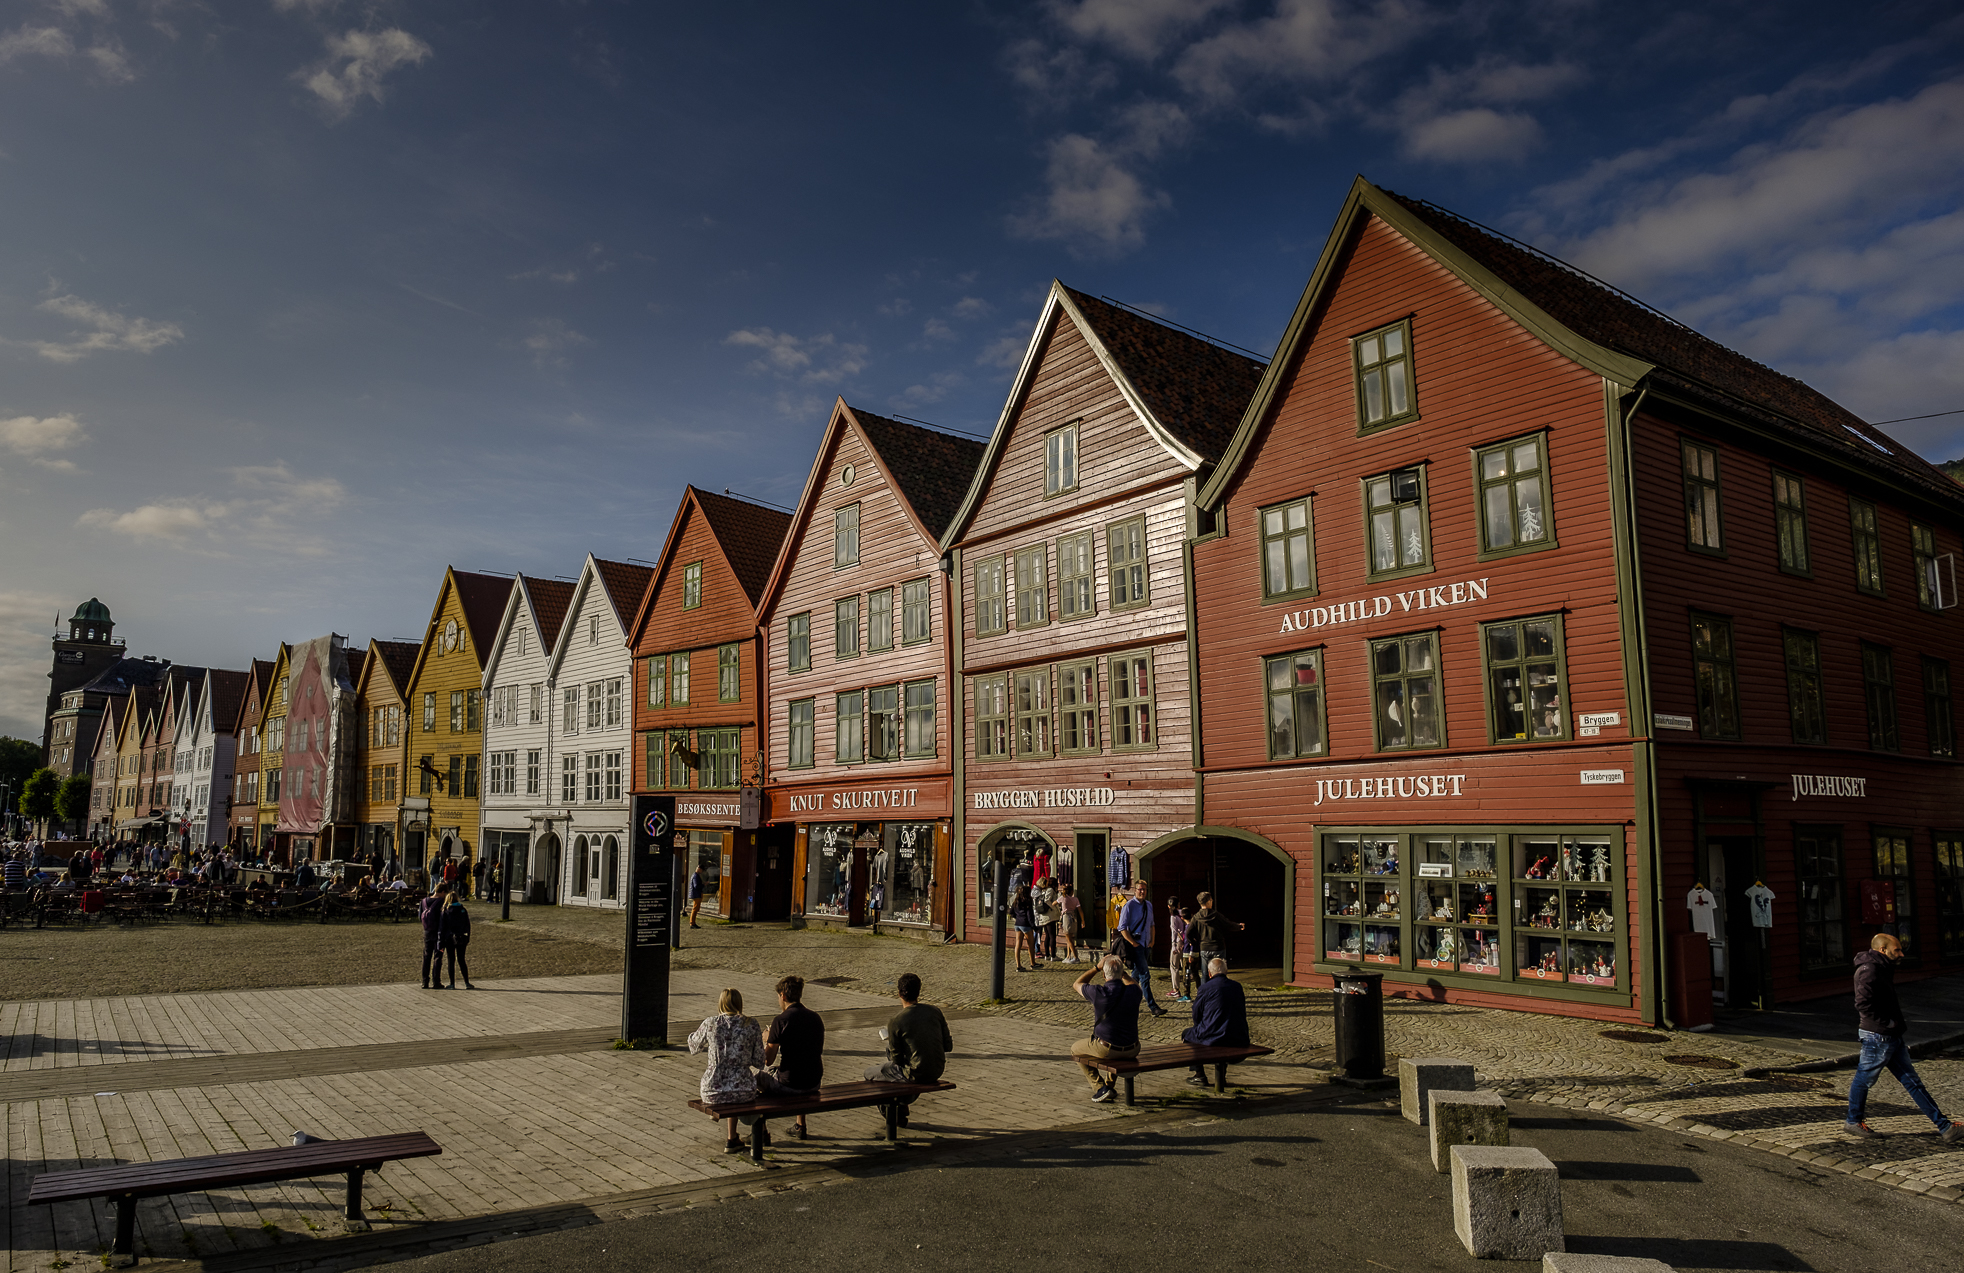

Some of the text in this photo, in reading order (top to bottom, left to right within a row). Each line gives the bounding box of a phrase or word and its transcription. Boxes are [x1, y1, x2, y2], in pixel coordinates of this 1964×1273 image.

[1279, 577, 1490, 634] AUDHILD VIKEN
[1584, 715, 1615, 726] Bryggen
[1583, 772, 1622, 783] Tyskebryggen
[1791, 773, 1867, 802] JULEHUSET
[789, 788, 919, 812] KNUT SKURTVEIT
[974, 787, 1115, 809] BRYGGEN HUSFLID
[1314, 774, 1467, 806] JULEHUSET
[677, 803, 741, 816] BESØKSSENTE
